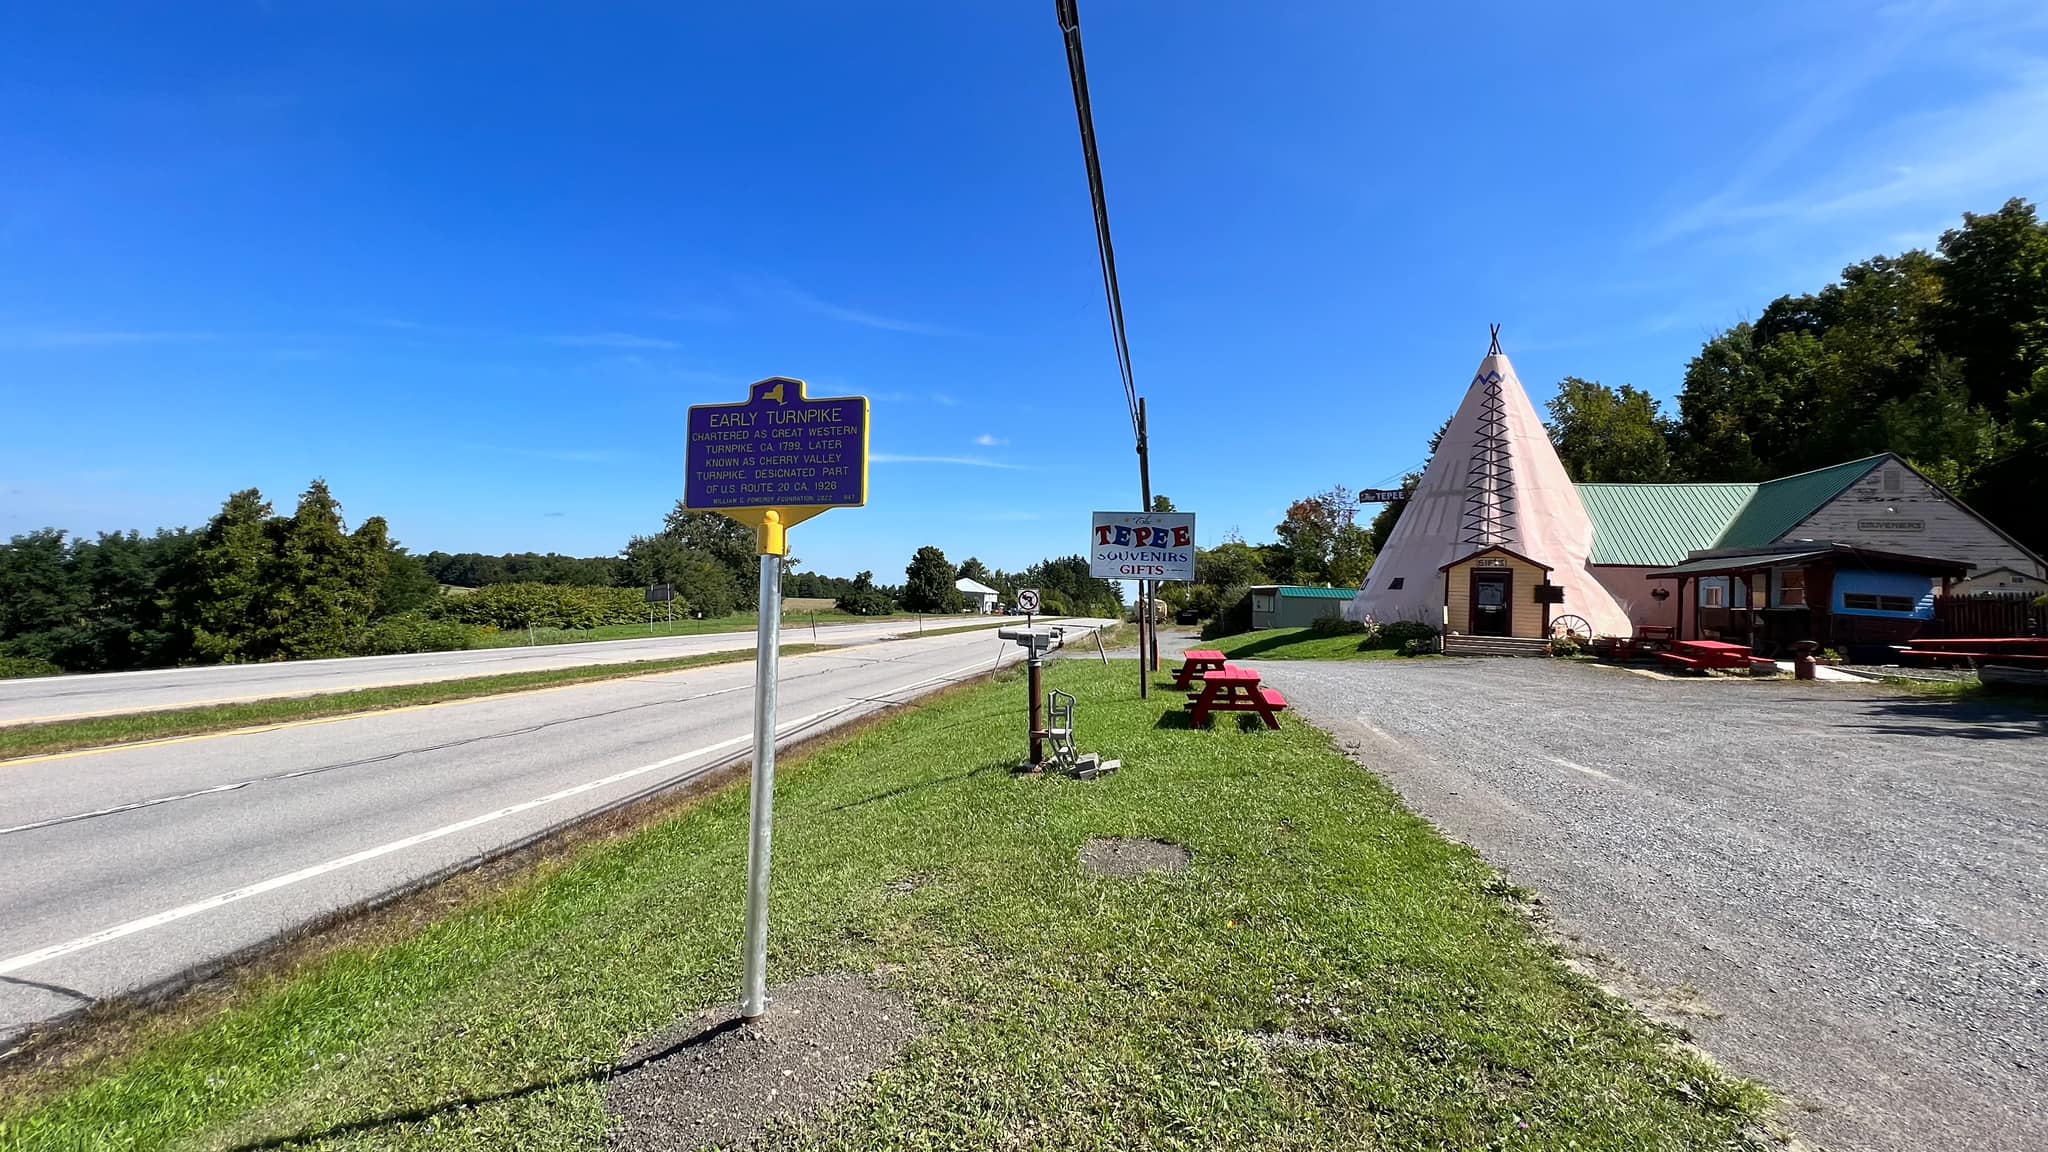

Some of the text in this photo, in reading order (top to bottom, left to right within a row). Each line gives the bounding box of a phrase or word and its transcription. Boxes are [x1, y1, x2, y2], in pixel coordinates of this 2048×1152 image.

[710, 407, 842, 428] EARLY TURNPIKE
[692, 425, 857, 442] CHARTERED AS GREAT WESTERN
[808, 439, 842, 450] LATER
[705, 453, 842, 468] KNOWN AS CHERRY VALLEY
[755, 467, 816, 479] DESIGNATED
[822, 466, 849, 476] PART
[706, 485, 719, 495] OF
[740, 482, 774, 493] ROUTE
[778, 482, 790, 492] 20
[815, 480, 838, 490] 1926
[1376, 491, 1405, 500] TEPEE
[1095, 525, 1191, 549] TEPEE
[1097, 551, 1188, 562] SOUVENIRS
[1120, 564, 1164, 576] GIFTS
